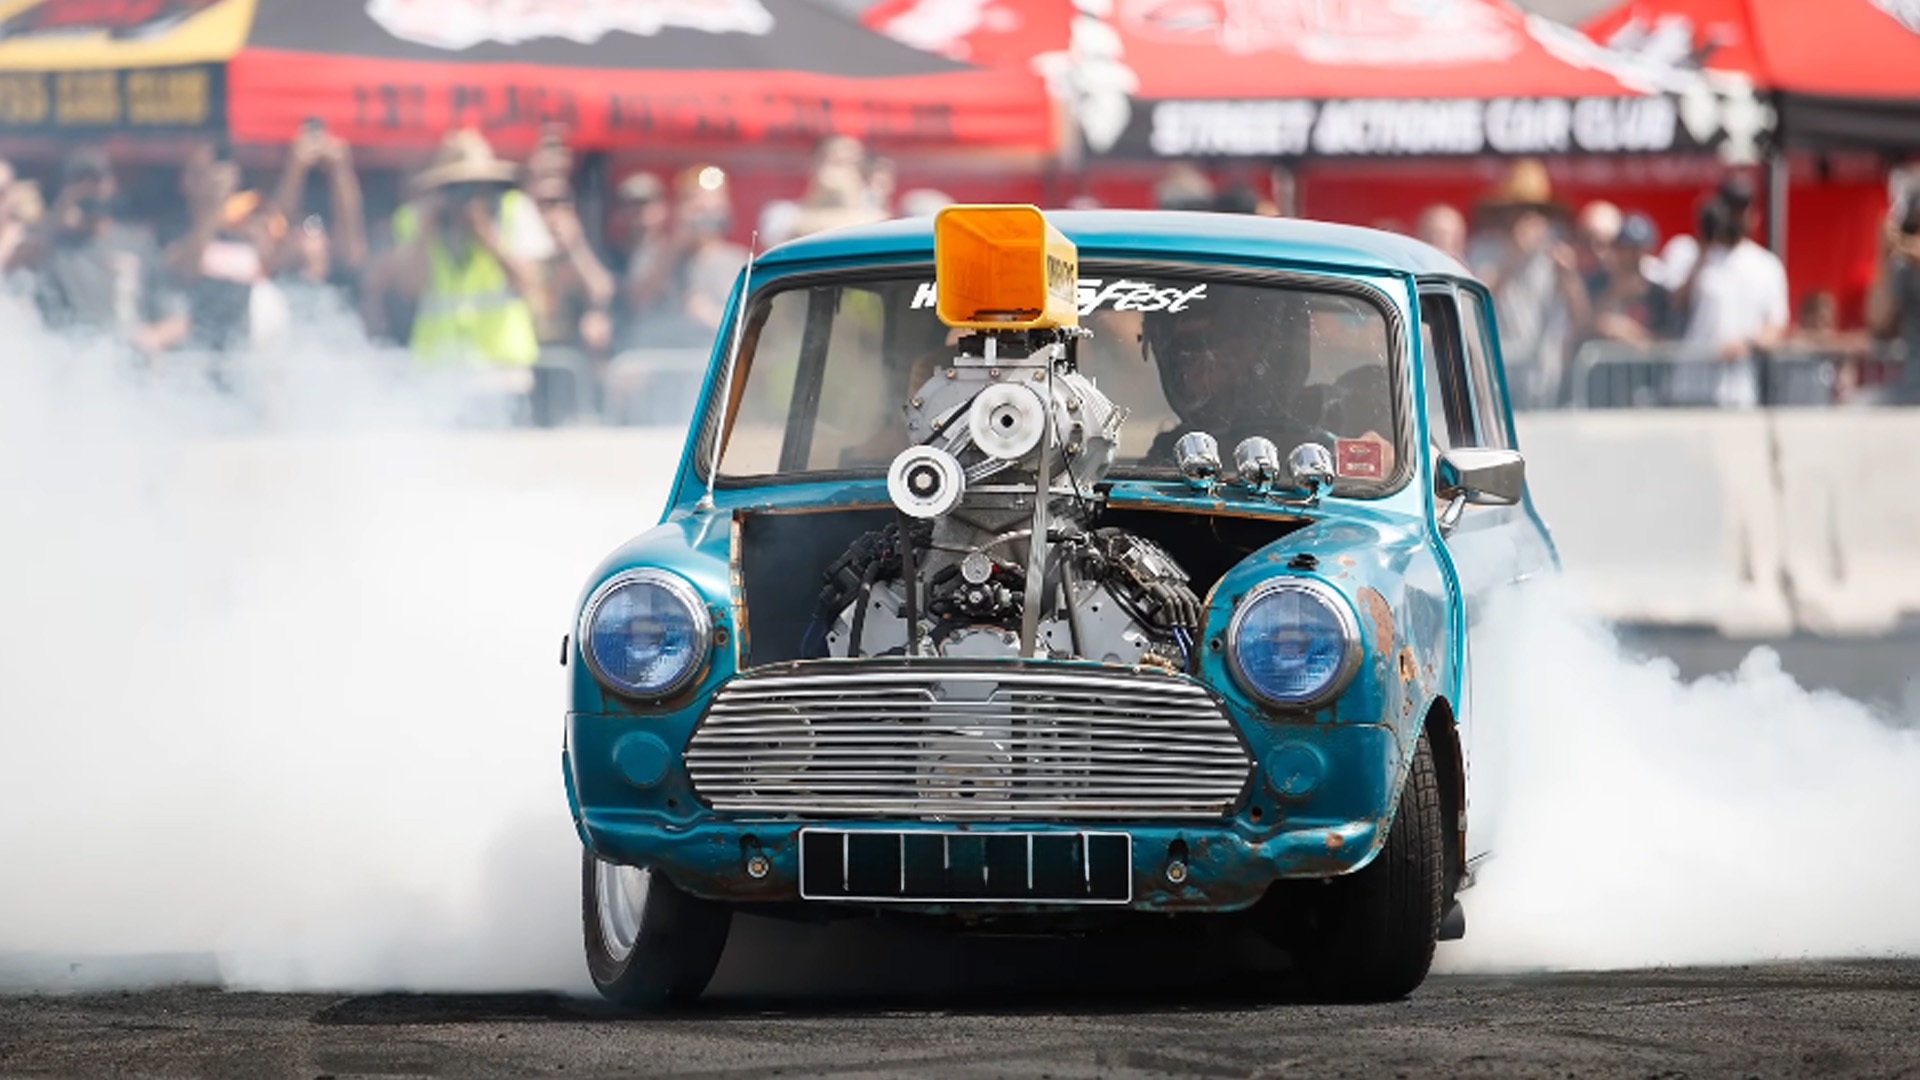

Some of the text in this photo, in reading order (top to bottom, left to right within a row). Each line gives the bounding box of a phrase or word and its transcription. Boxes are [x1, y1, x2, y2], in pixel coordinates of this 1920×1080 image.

[1152, 98, 1314, 155] STREET
[1486, 97, 1571, 153] CAR
[1573, 97, 1677, 152] CLUB
